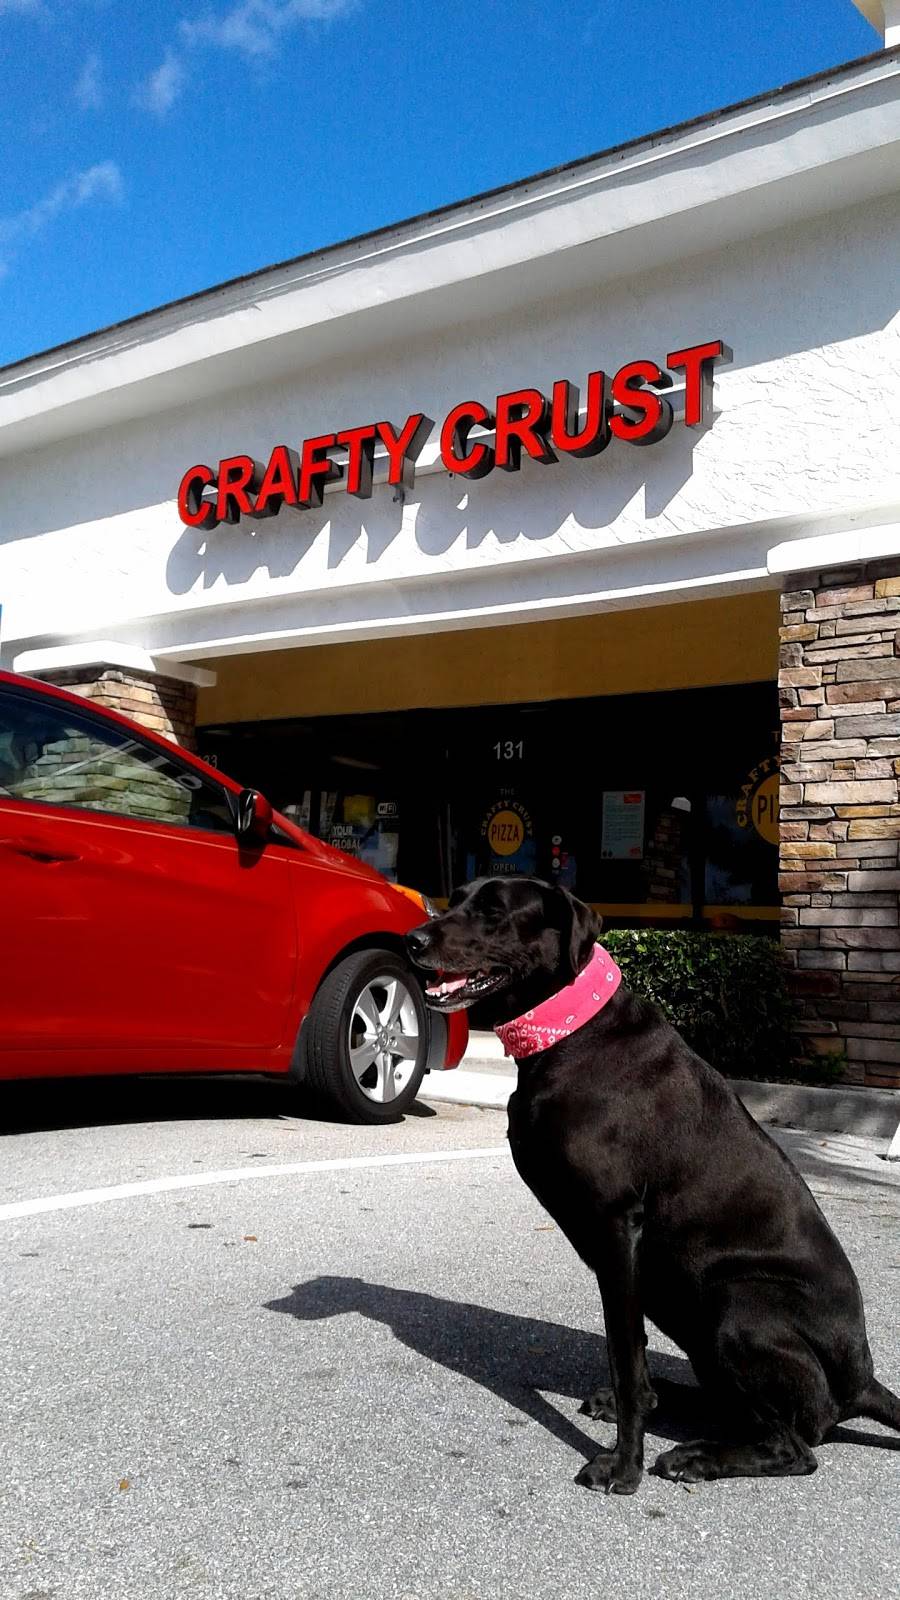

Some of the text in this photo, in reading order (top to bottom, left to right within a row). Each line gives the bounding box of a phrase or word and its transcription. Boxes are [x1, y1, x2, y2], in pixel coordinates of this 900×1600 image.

[177, 341, 725, 529] CRAFTY CRUST
[493, 740, 523, 760] 131
[757, 794, 779, 825] PI
[491, 823, 519, 841] PIZZA
